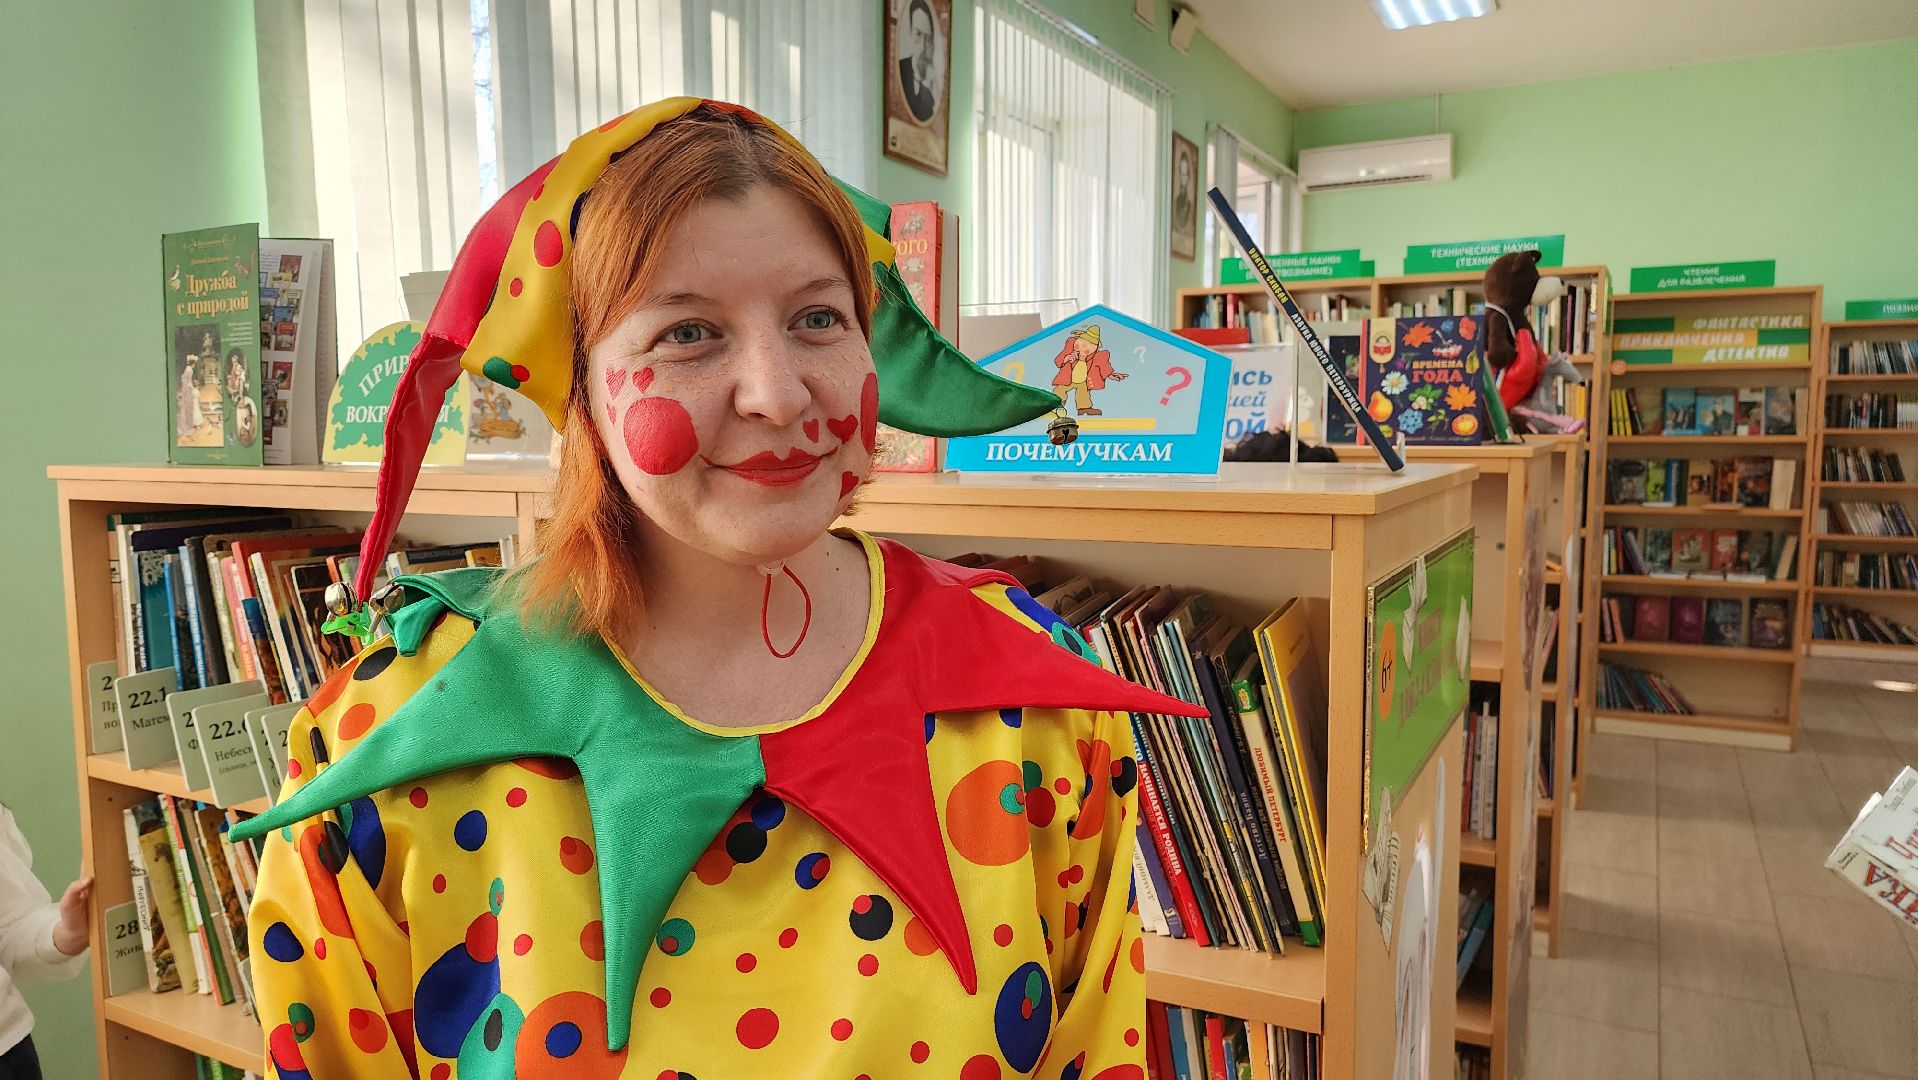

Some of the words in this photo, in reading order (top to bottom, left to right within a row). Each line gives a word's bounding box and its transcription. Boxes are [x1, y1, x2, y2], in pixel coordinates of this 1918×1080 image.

[893, 239, 929, 256] ого
[1431, 245, 1501, 258] ТЕХНИЧЕСКИЕ
[185, 270, 237, 297] Дружба
[177, 303, 185, 315] с
[187, 289, 249, 320] природой
[1692, 315, 1803, 330] ФАНТАСТИКА
[1620, 332, 1745, 347] ПРИКЛЮЧЕНИЯ
[1703, 345, 1790, 362] ДЕТЕКТИВ
[1291, 313, 1313, 342] АЗБУКА
[1308, 339, 1330, 365] ЮНОГО
[1325, 363, 1362, 413] ПЕТЕРБУРЖЦА
[1412, 360, 1463, 369] ВРЕМЕНА
[1412, 369, 1463, 384] ГОДА
[985, 442, 1173, 466] ПОЧЕМУЧКАМ
[1254, 747, 1274, 795] ЛЮБИМЫЙ
[1268, 794, 1287, 843] ПЕТЕРБУРГ
[1139, 763, 1167, 831] НАЧИНАЕТСЯ
[1162, 832, 1182, 876] РОДИНА
